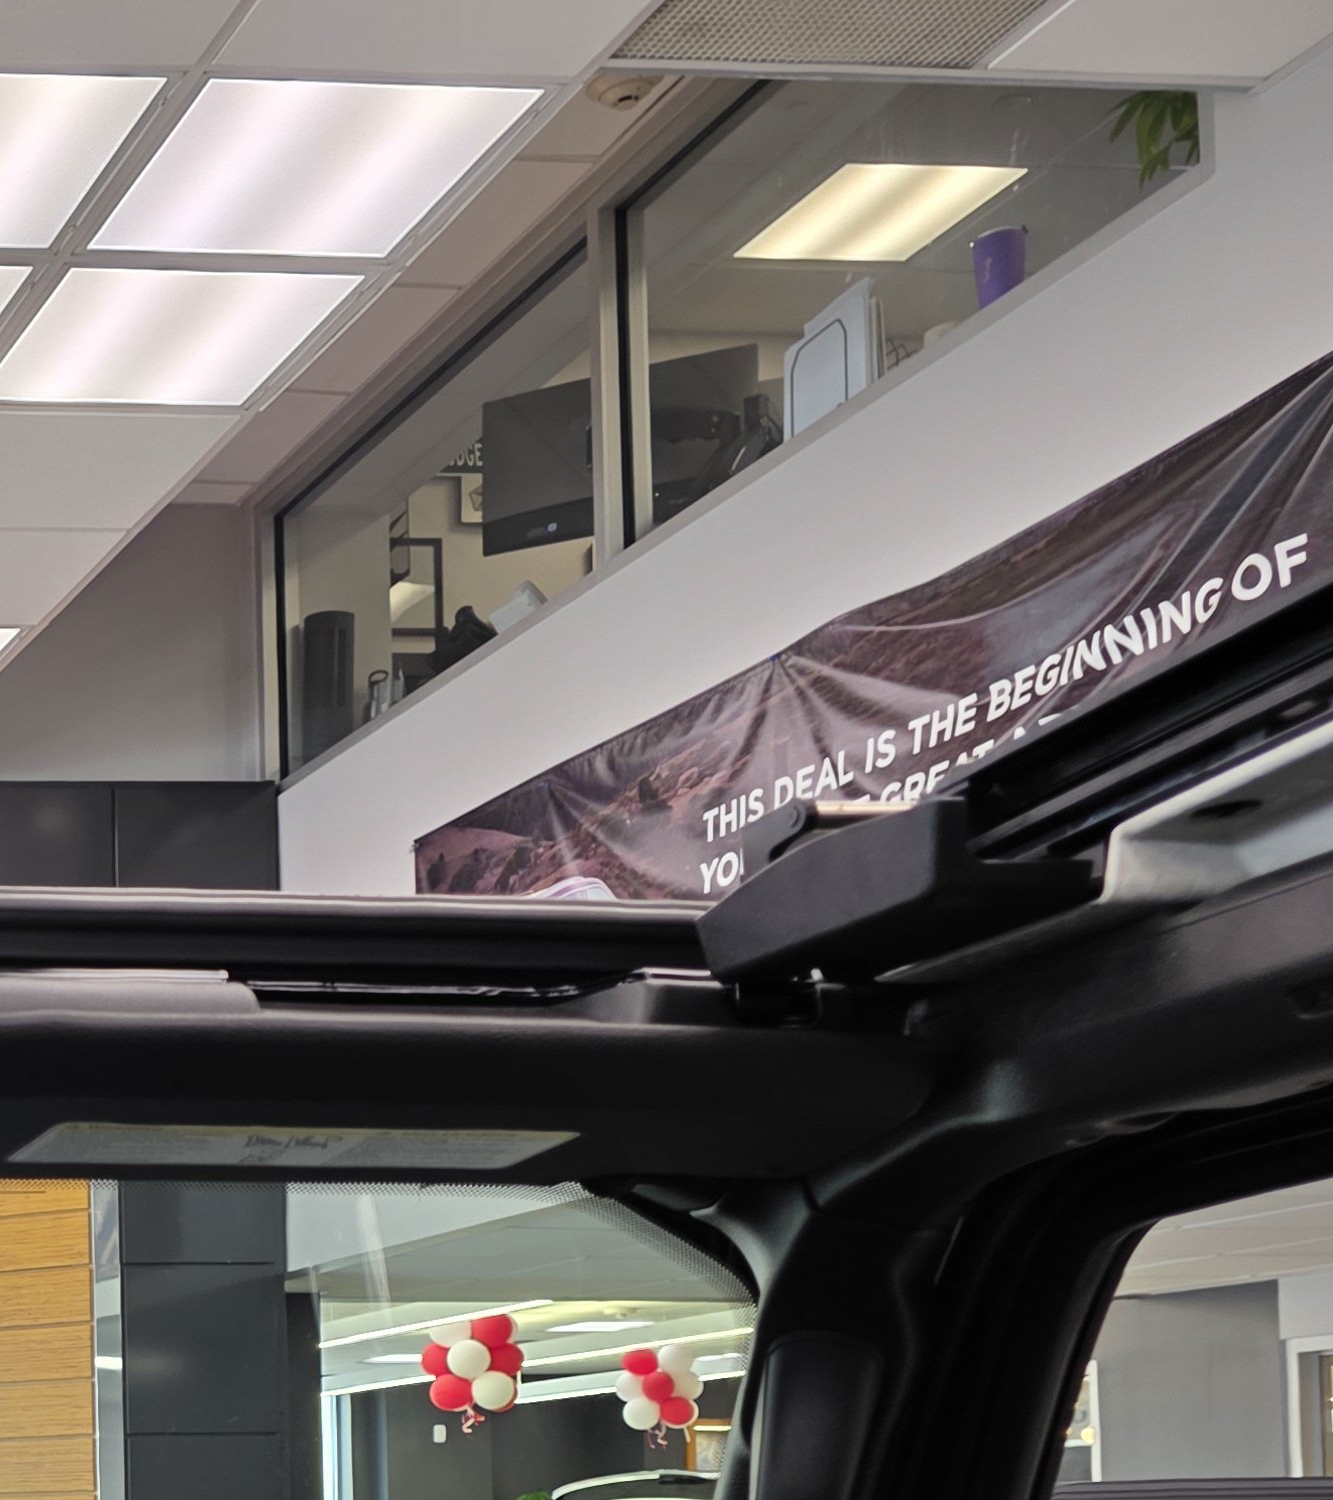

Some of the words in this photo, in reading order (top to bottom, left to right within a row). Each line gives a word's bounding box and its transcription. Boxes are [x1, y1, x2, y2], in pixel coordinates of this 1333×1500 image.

[702, 794, 764, 842] THIS
[773, 750, 854, 811] DEAL
[865, 729, 897, 774] IS
[908, 692, 978, 755] THE
[987, 577, 1224, 722] BEGINNING
[1231, 533, 1308, 601] OF
